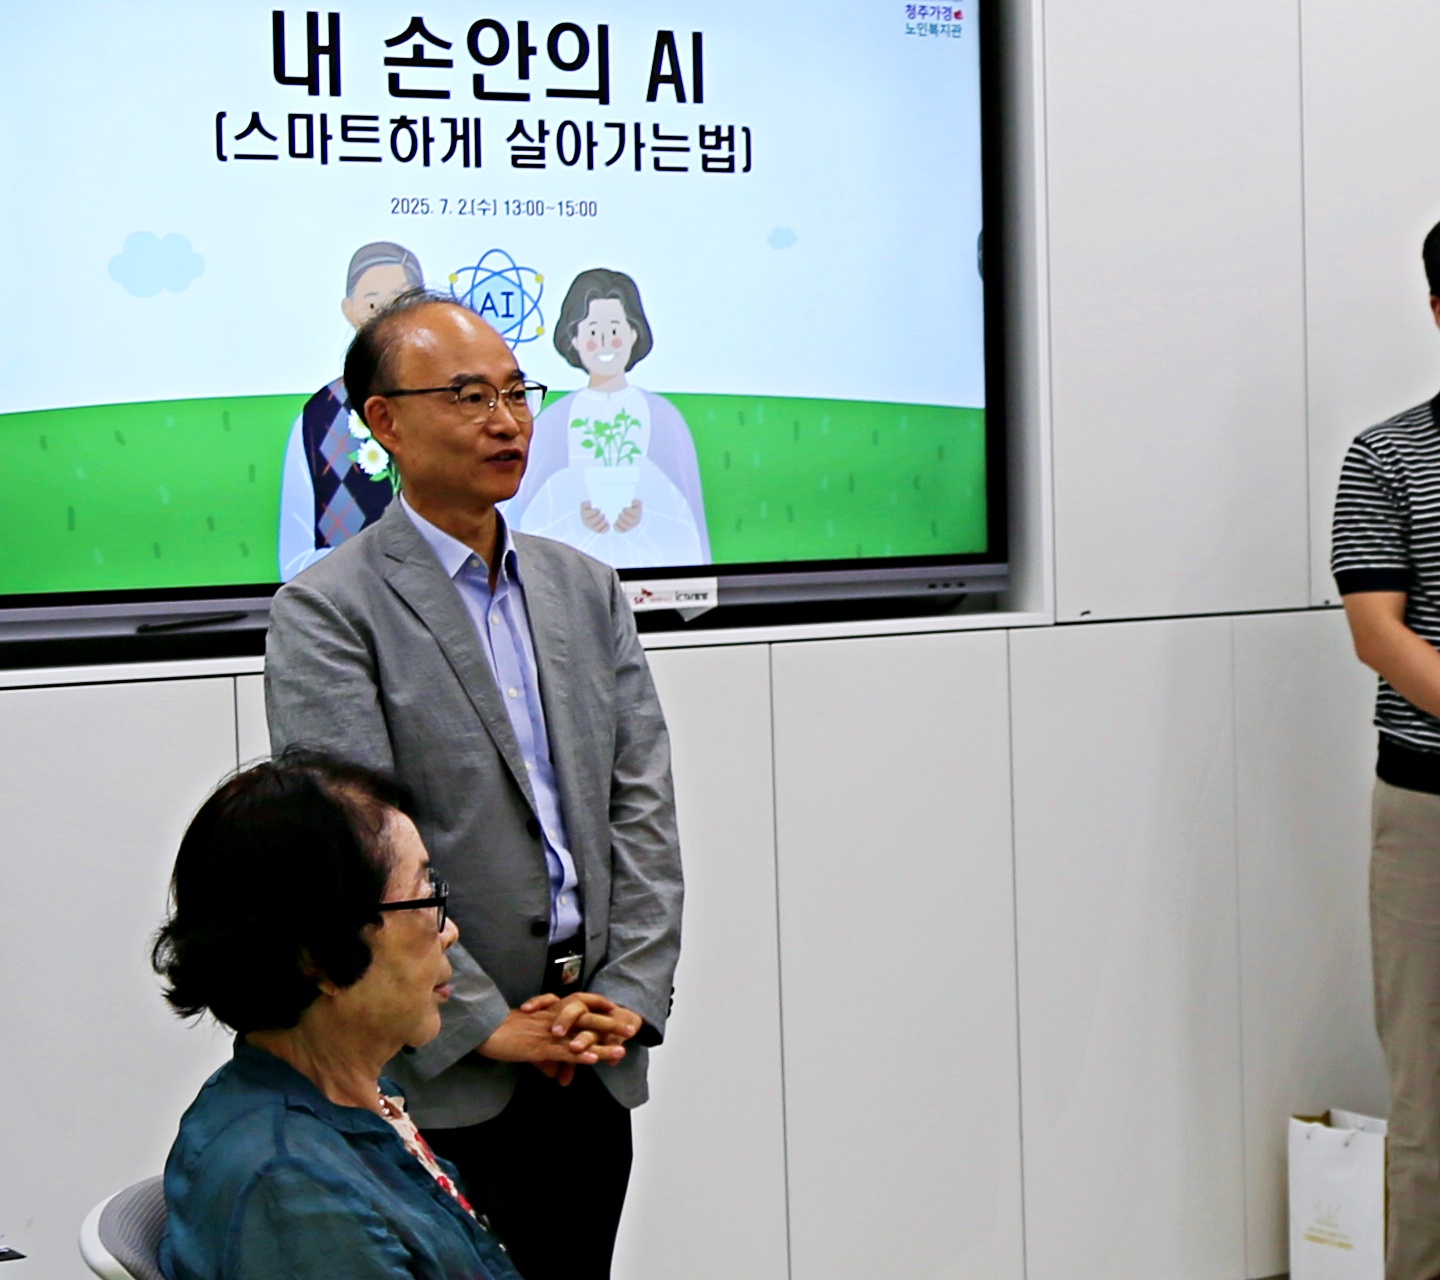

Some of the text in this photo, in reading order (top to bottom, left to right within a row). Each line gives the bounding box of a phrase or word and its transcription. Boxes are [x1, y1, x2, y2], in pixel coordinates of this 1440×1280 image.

[905, 4, 953, 21] 청주가경
[905, 22, 962, 38] 노인복지관
[272, 10, 704, 106] 내 손안의 AI
[390, 197, 434, 216] 2025.
[439, 198, 453, 215] 7.
[504, 199, 598, 218] 13:00~15:00
[480, 291, 515, 318] AI
